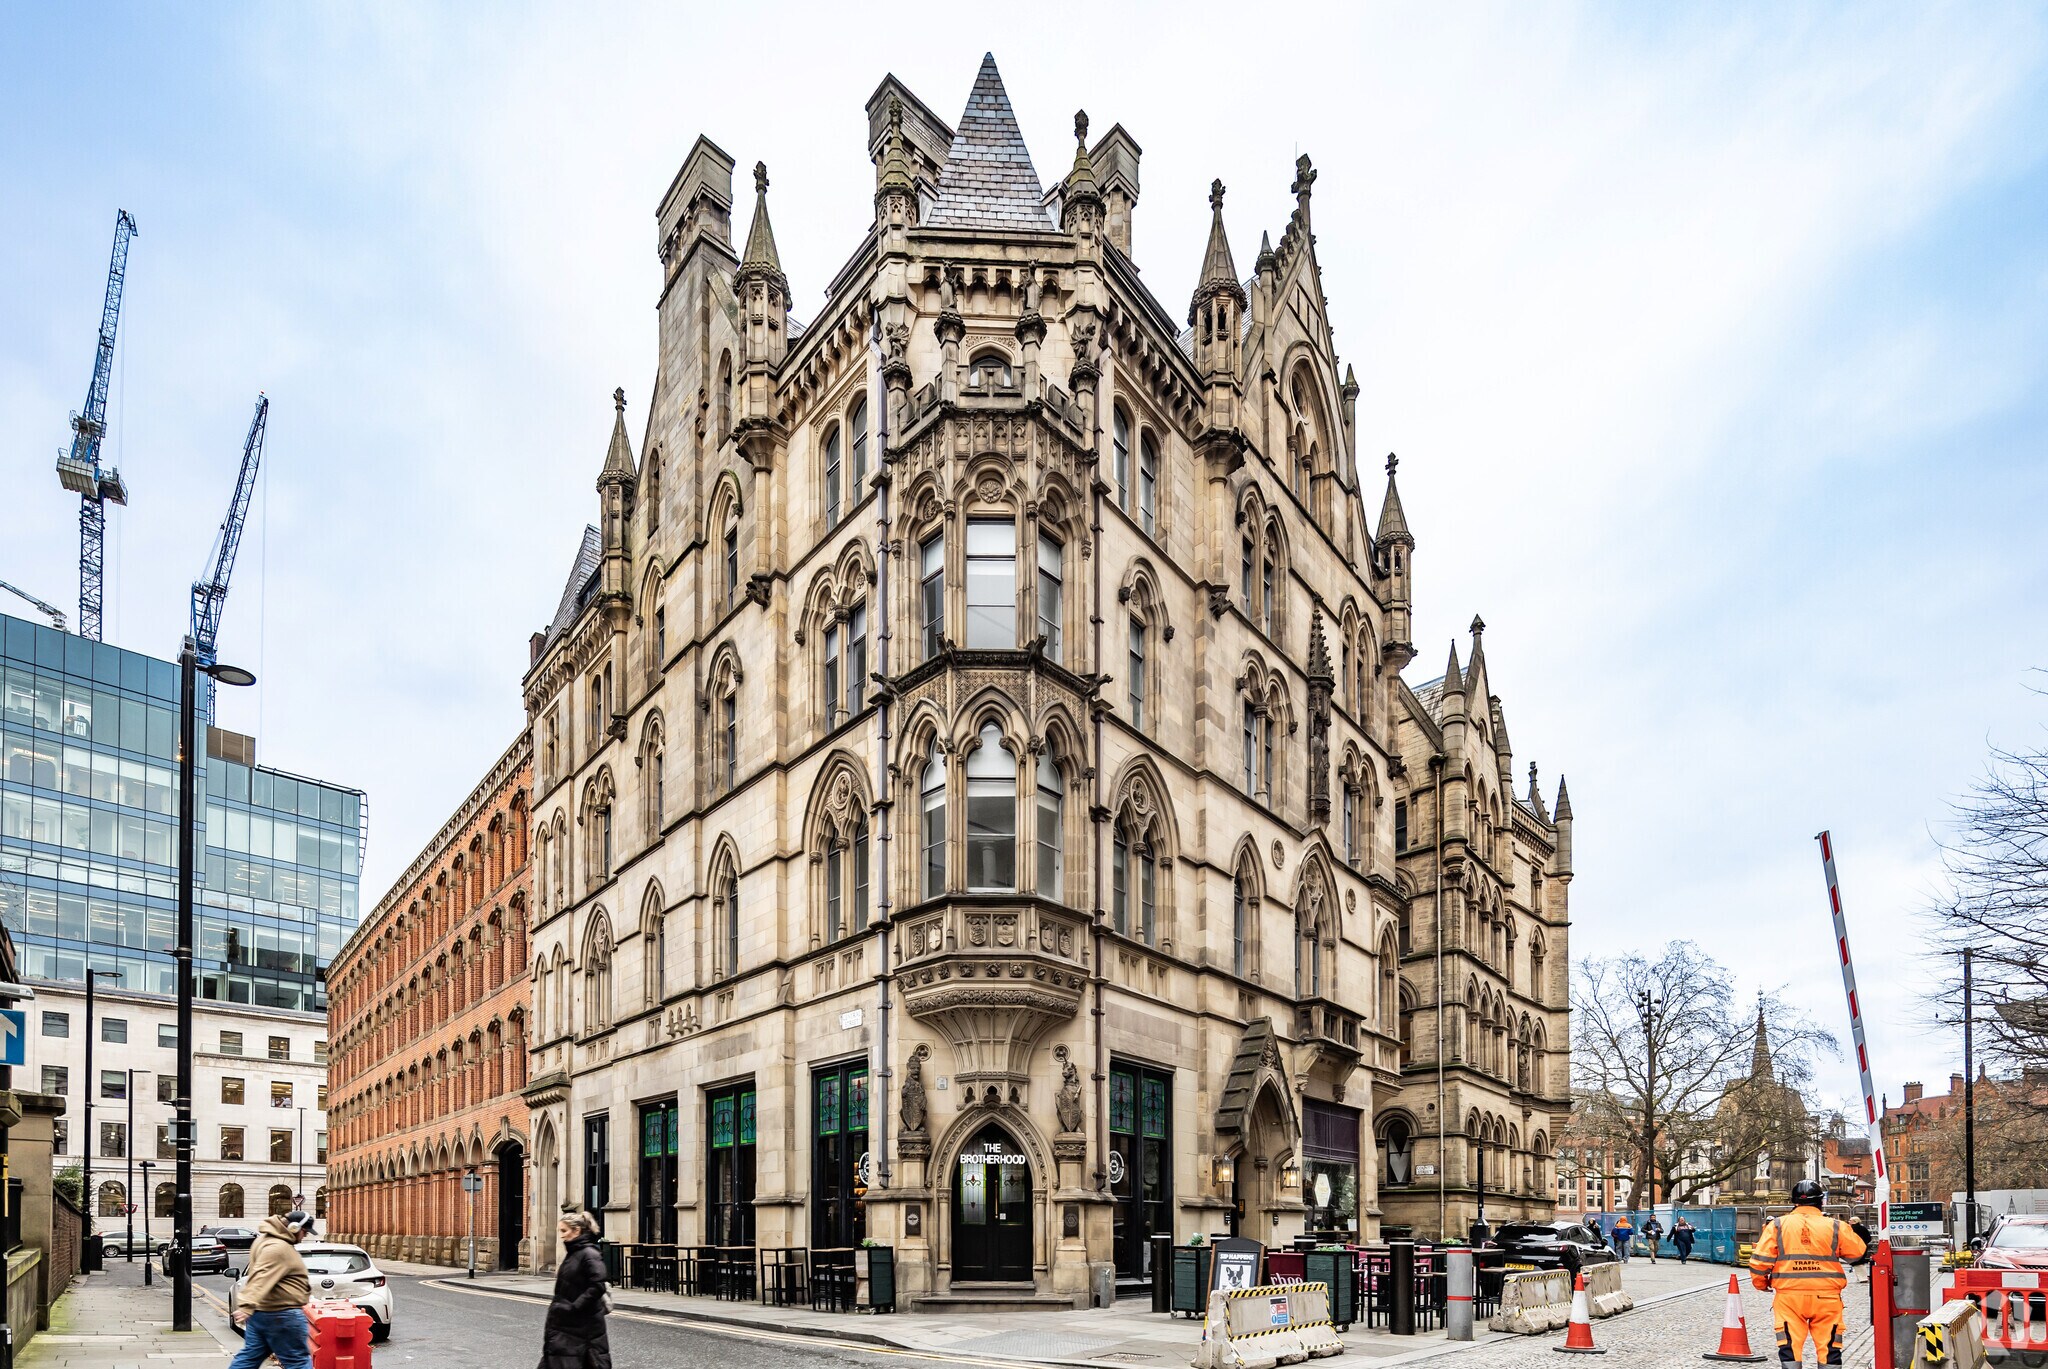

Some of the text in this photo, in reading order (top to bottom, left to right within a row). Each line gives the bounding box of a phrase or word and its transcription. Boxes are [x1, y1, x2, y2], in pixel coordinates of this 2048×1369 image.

[983, 1143, 1001, 1153] THE
[960, 1154, 1026, 1165] BROTHERHOOD
[1229, 1253, 1255, 1261] HAPPENS
